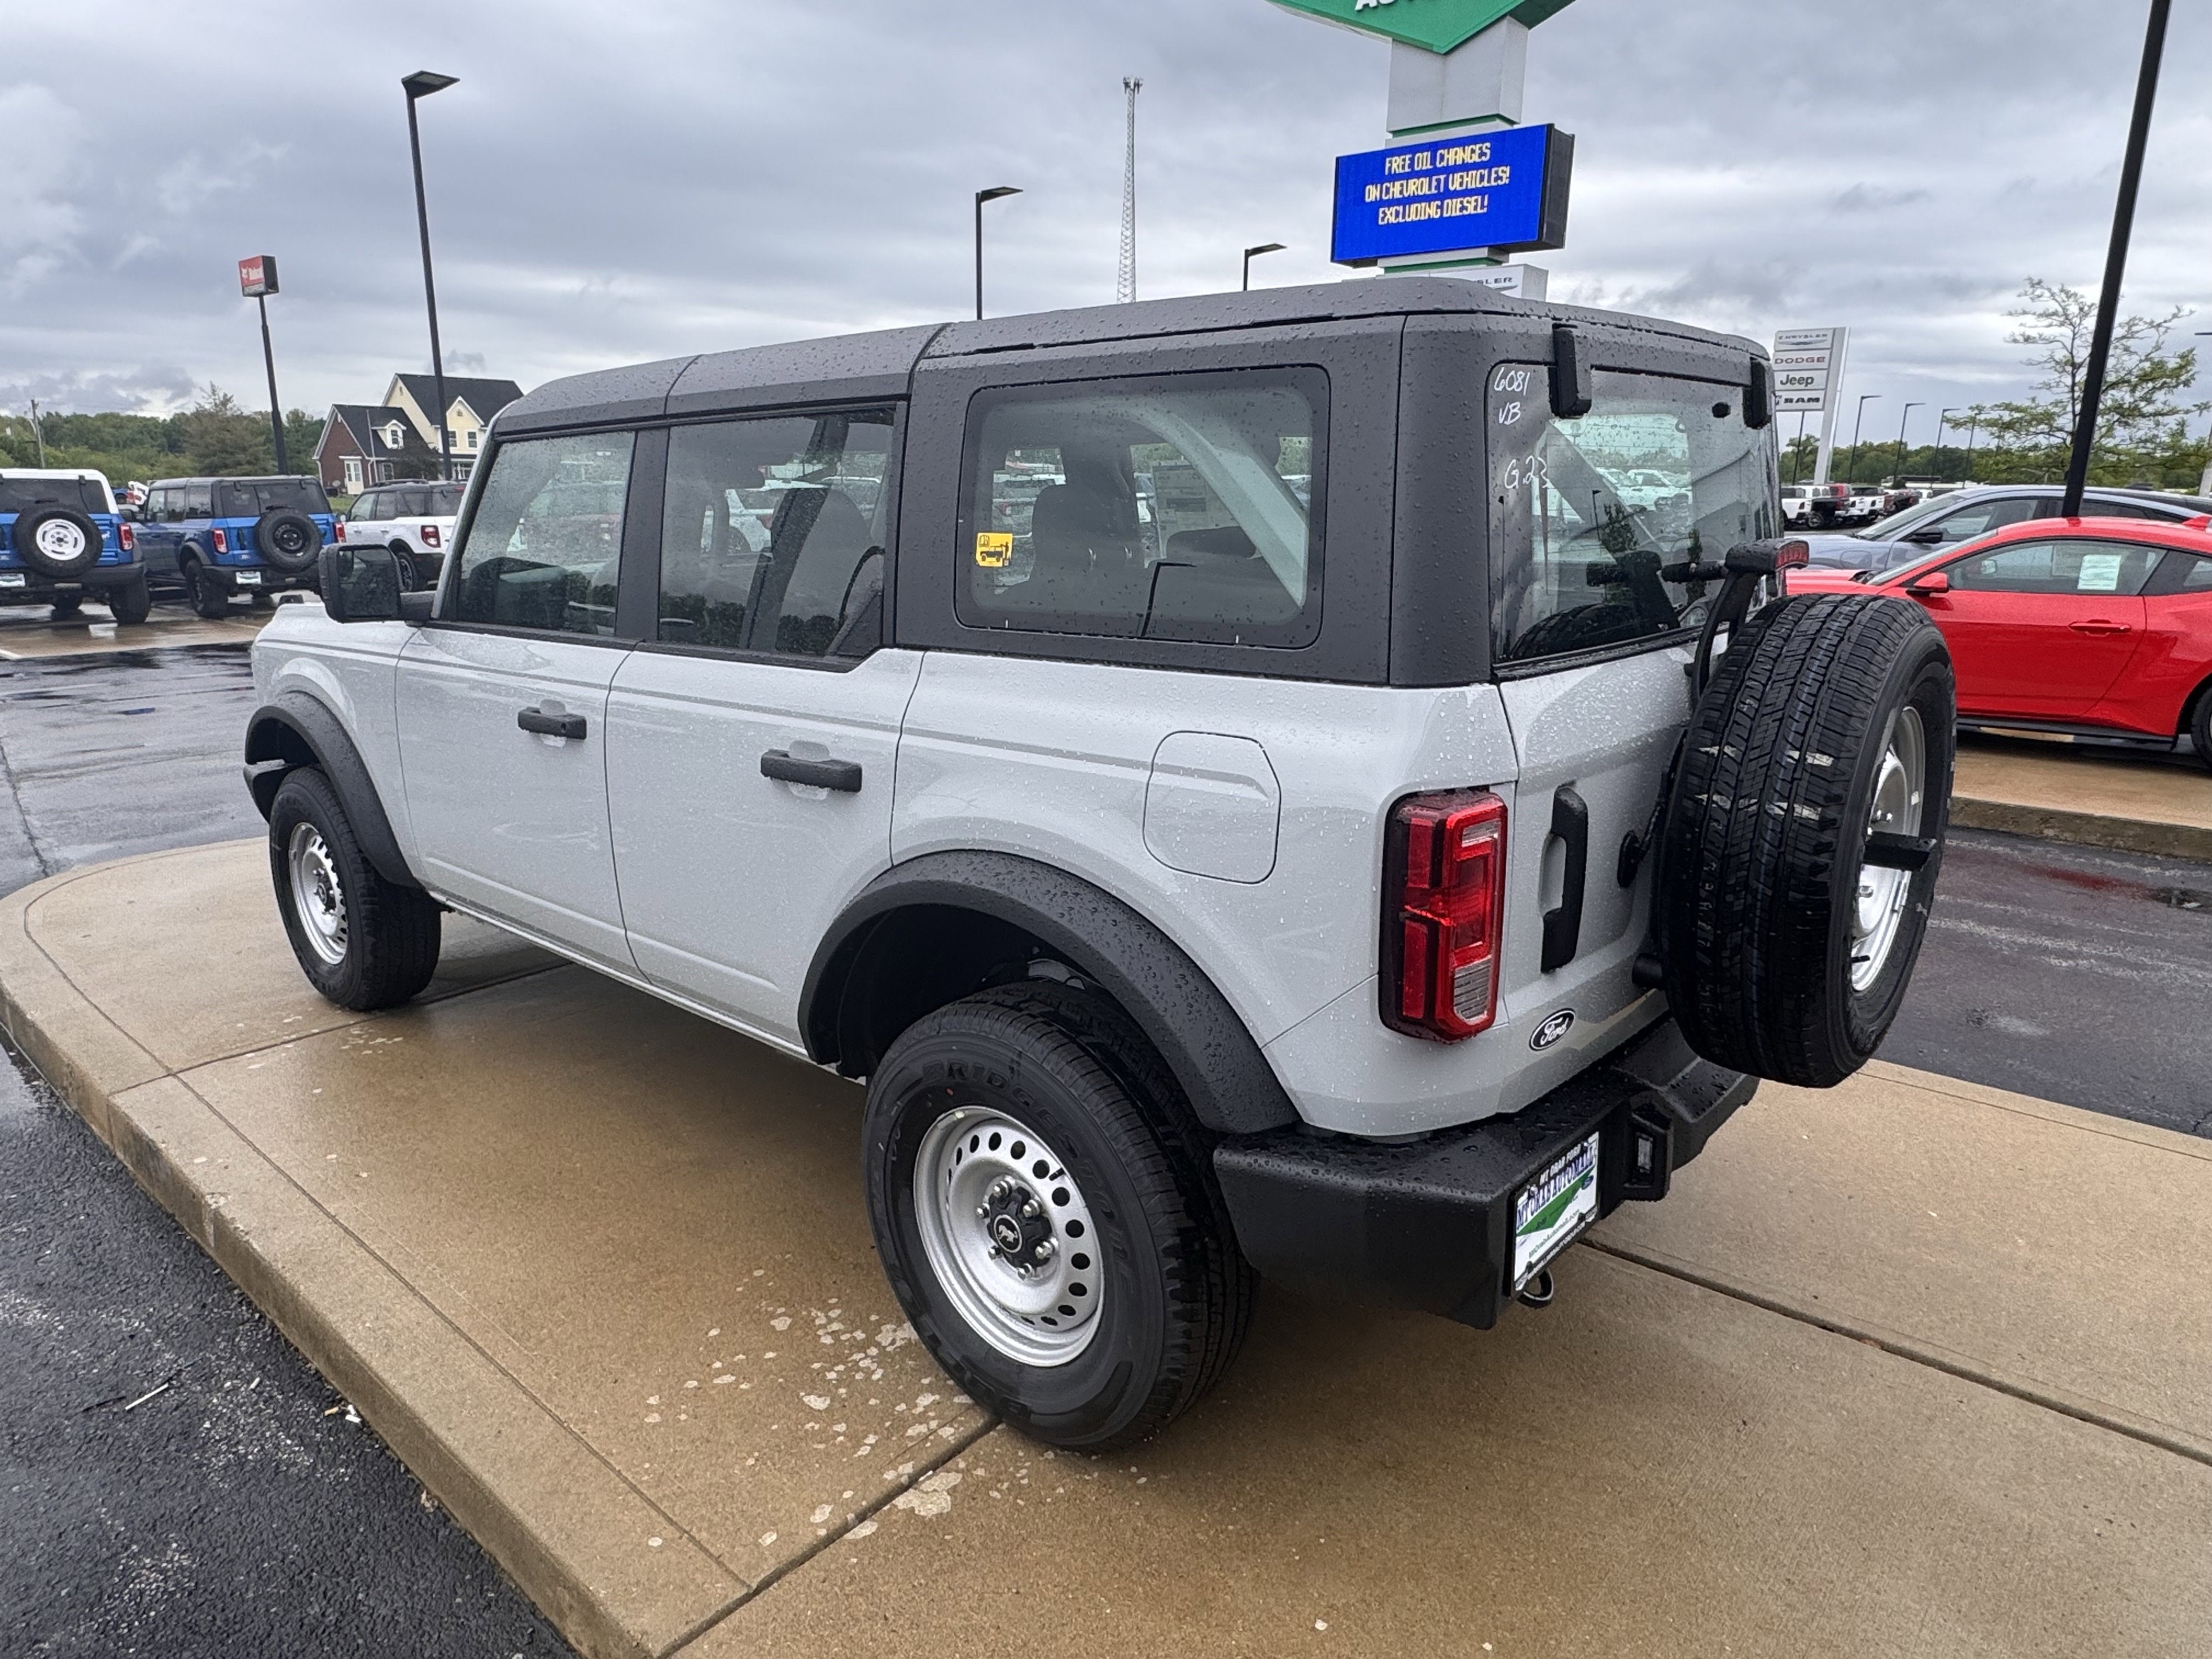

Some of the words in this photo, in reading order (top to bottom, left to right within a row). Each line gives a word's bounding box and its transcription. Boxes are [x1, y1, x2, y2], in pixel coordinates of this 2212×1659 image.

[1385, 154, 1412, 176] FREE
[1414, 150, 1434, 171] OIL
[1436, 142, 1491, 168] CHANGES
[1364, 183, 1381, 203] ON
[1381, 174, 1447, 200] CHEVROLET
[1448, 165, 1510, 191] VEHICLES!
[1378, 201, 1441, 225] EXCLUDING
[1443, 194, 1489, 217] DIESEL!
[1493, 366, 1531, 396] 6081
[1780, 374, 1815, 387] Jeep
[1539, 1015, 1570, 1046] Ford
